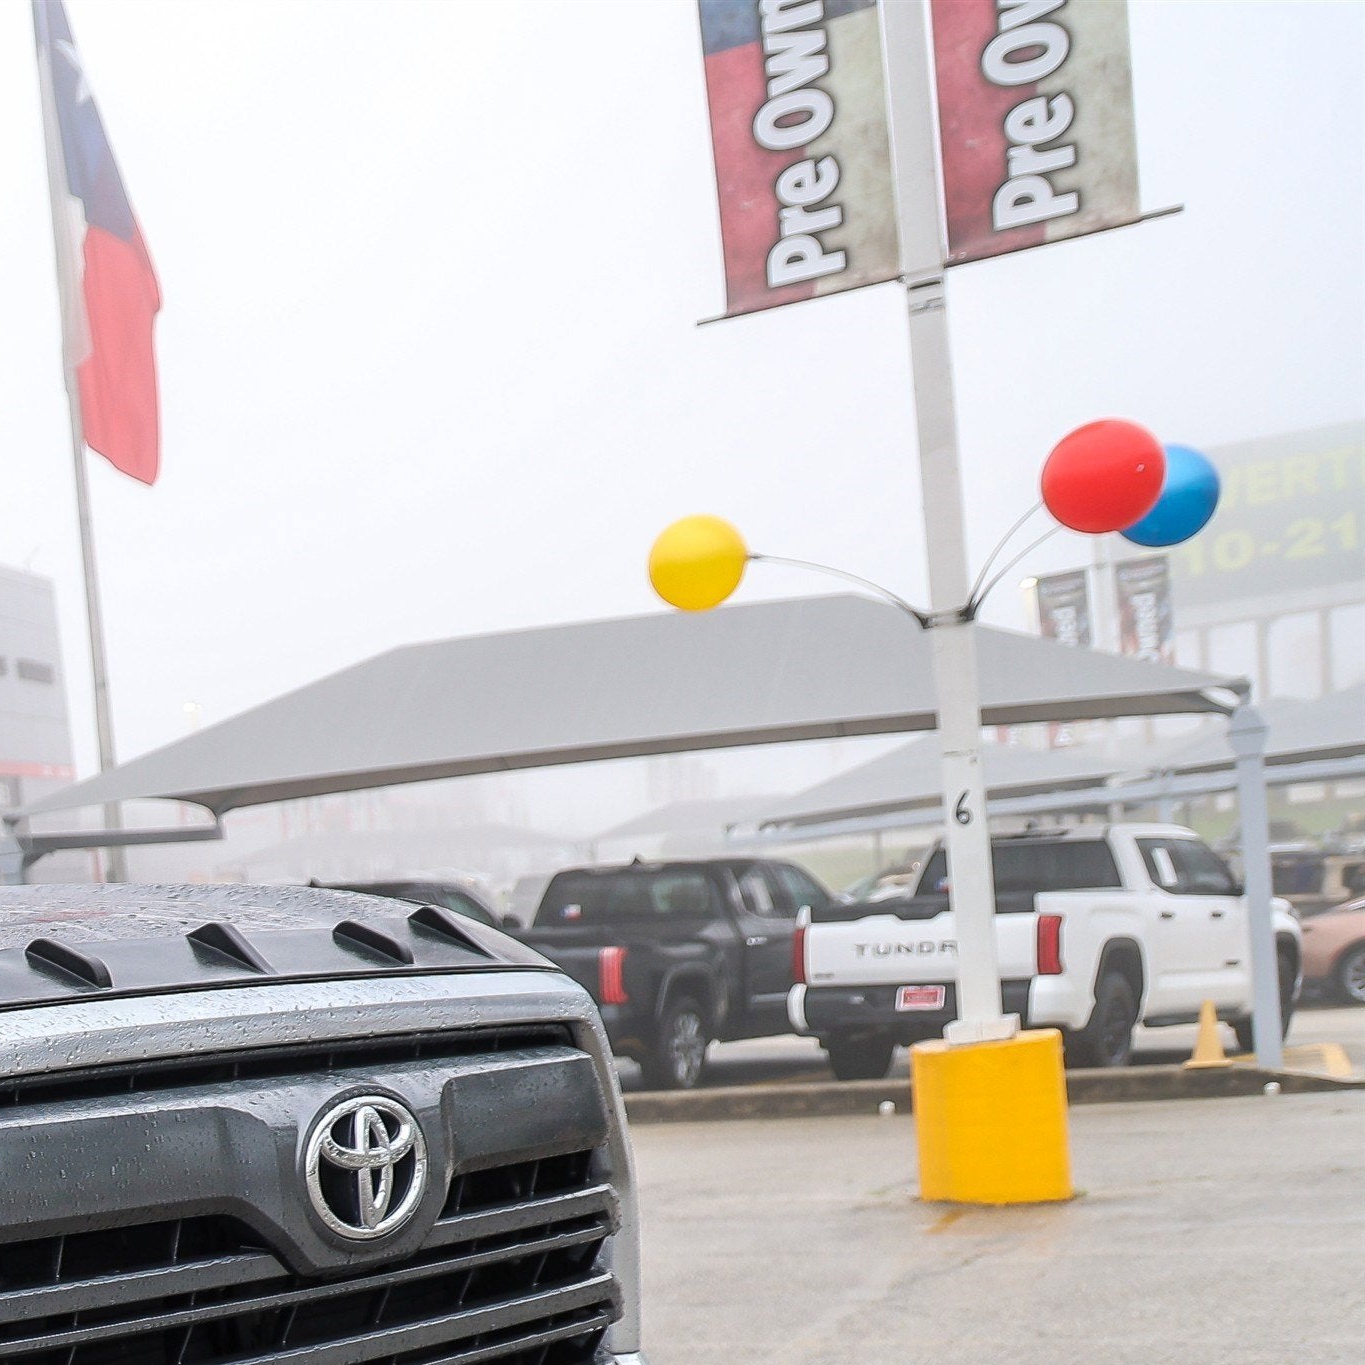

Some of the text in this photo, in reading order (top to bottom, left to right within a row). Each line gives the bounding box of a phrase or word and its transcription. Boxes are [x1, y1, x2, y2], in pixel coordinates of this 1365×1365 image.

[992, 93, 1078, 231] Pre
[767, 155, 847, 287] Pre
[955, 790, 970, 825] 6
[854, 940, 959, 958] TUNDR
